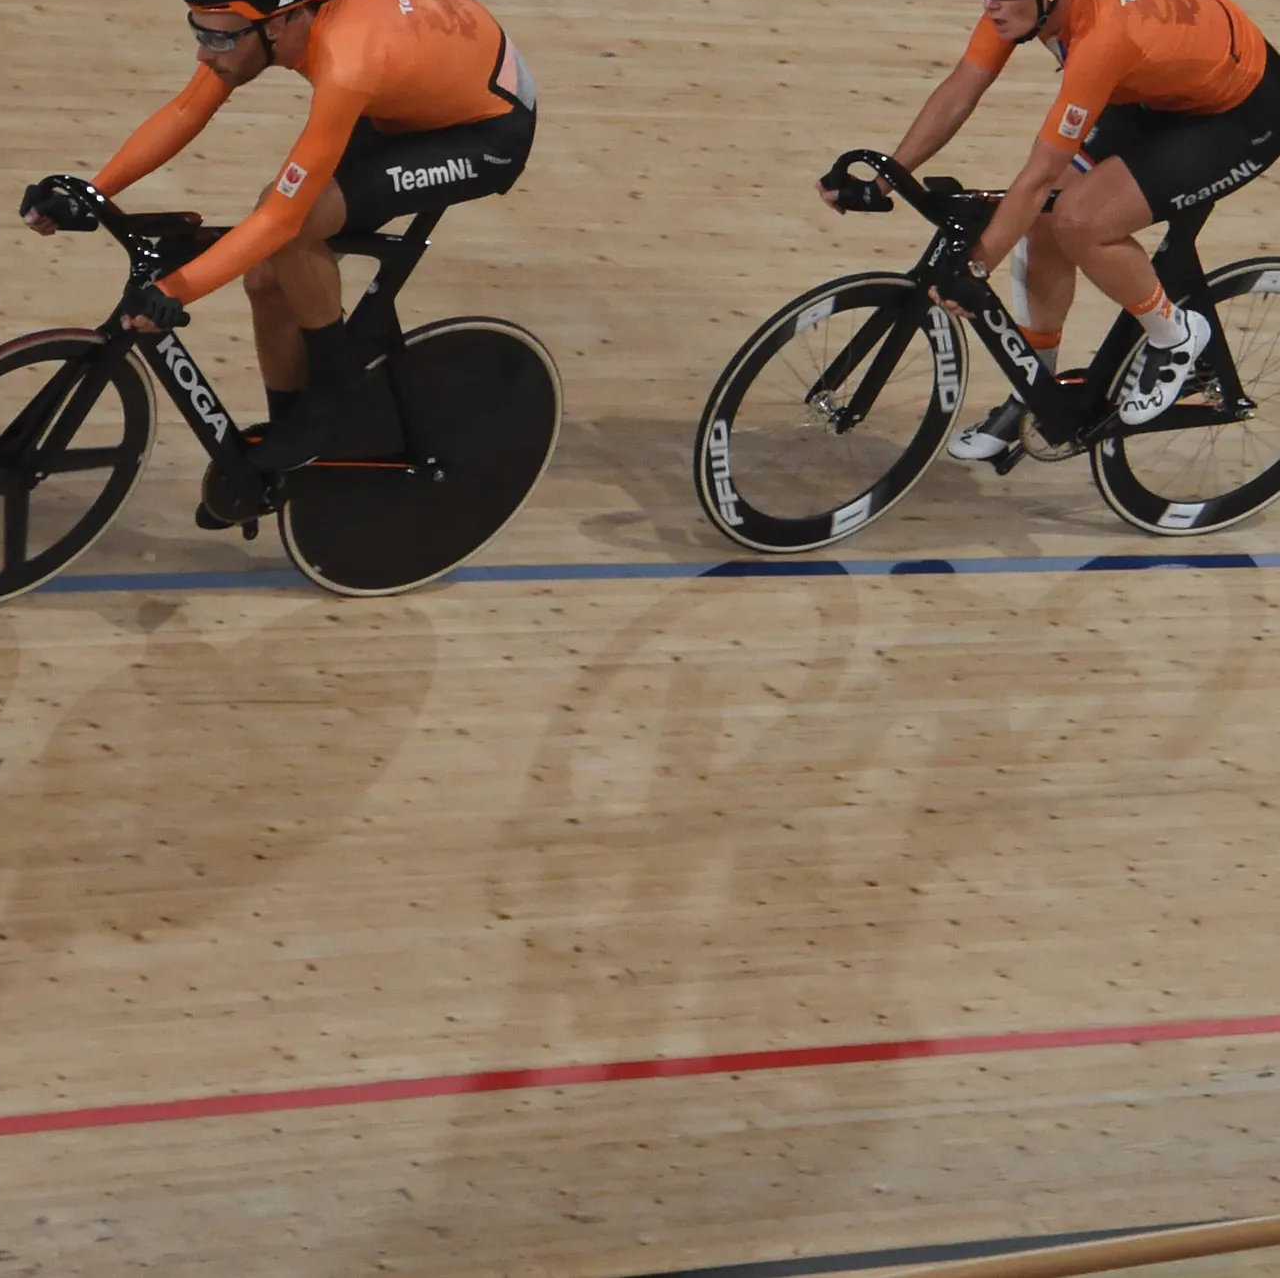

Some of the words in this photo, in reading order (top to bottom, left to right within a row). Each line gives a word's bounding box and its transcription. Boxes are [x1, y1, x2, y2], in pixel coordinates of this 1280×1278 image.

[385, 158, 479, 193] TeamNL
[1170, 159, 1264, 211] TeamNL
[983, 308, 1039, 387] OGA
[156, 333, 229, 444] KOGA
